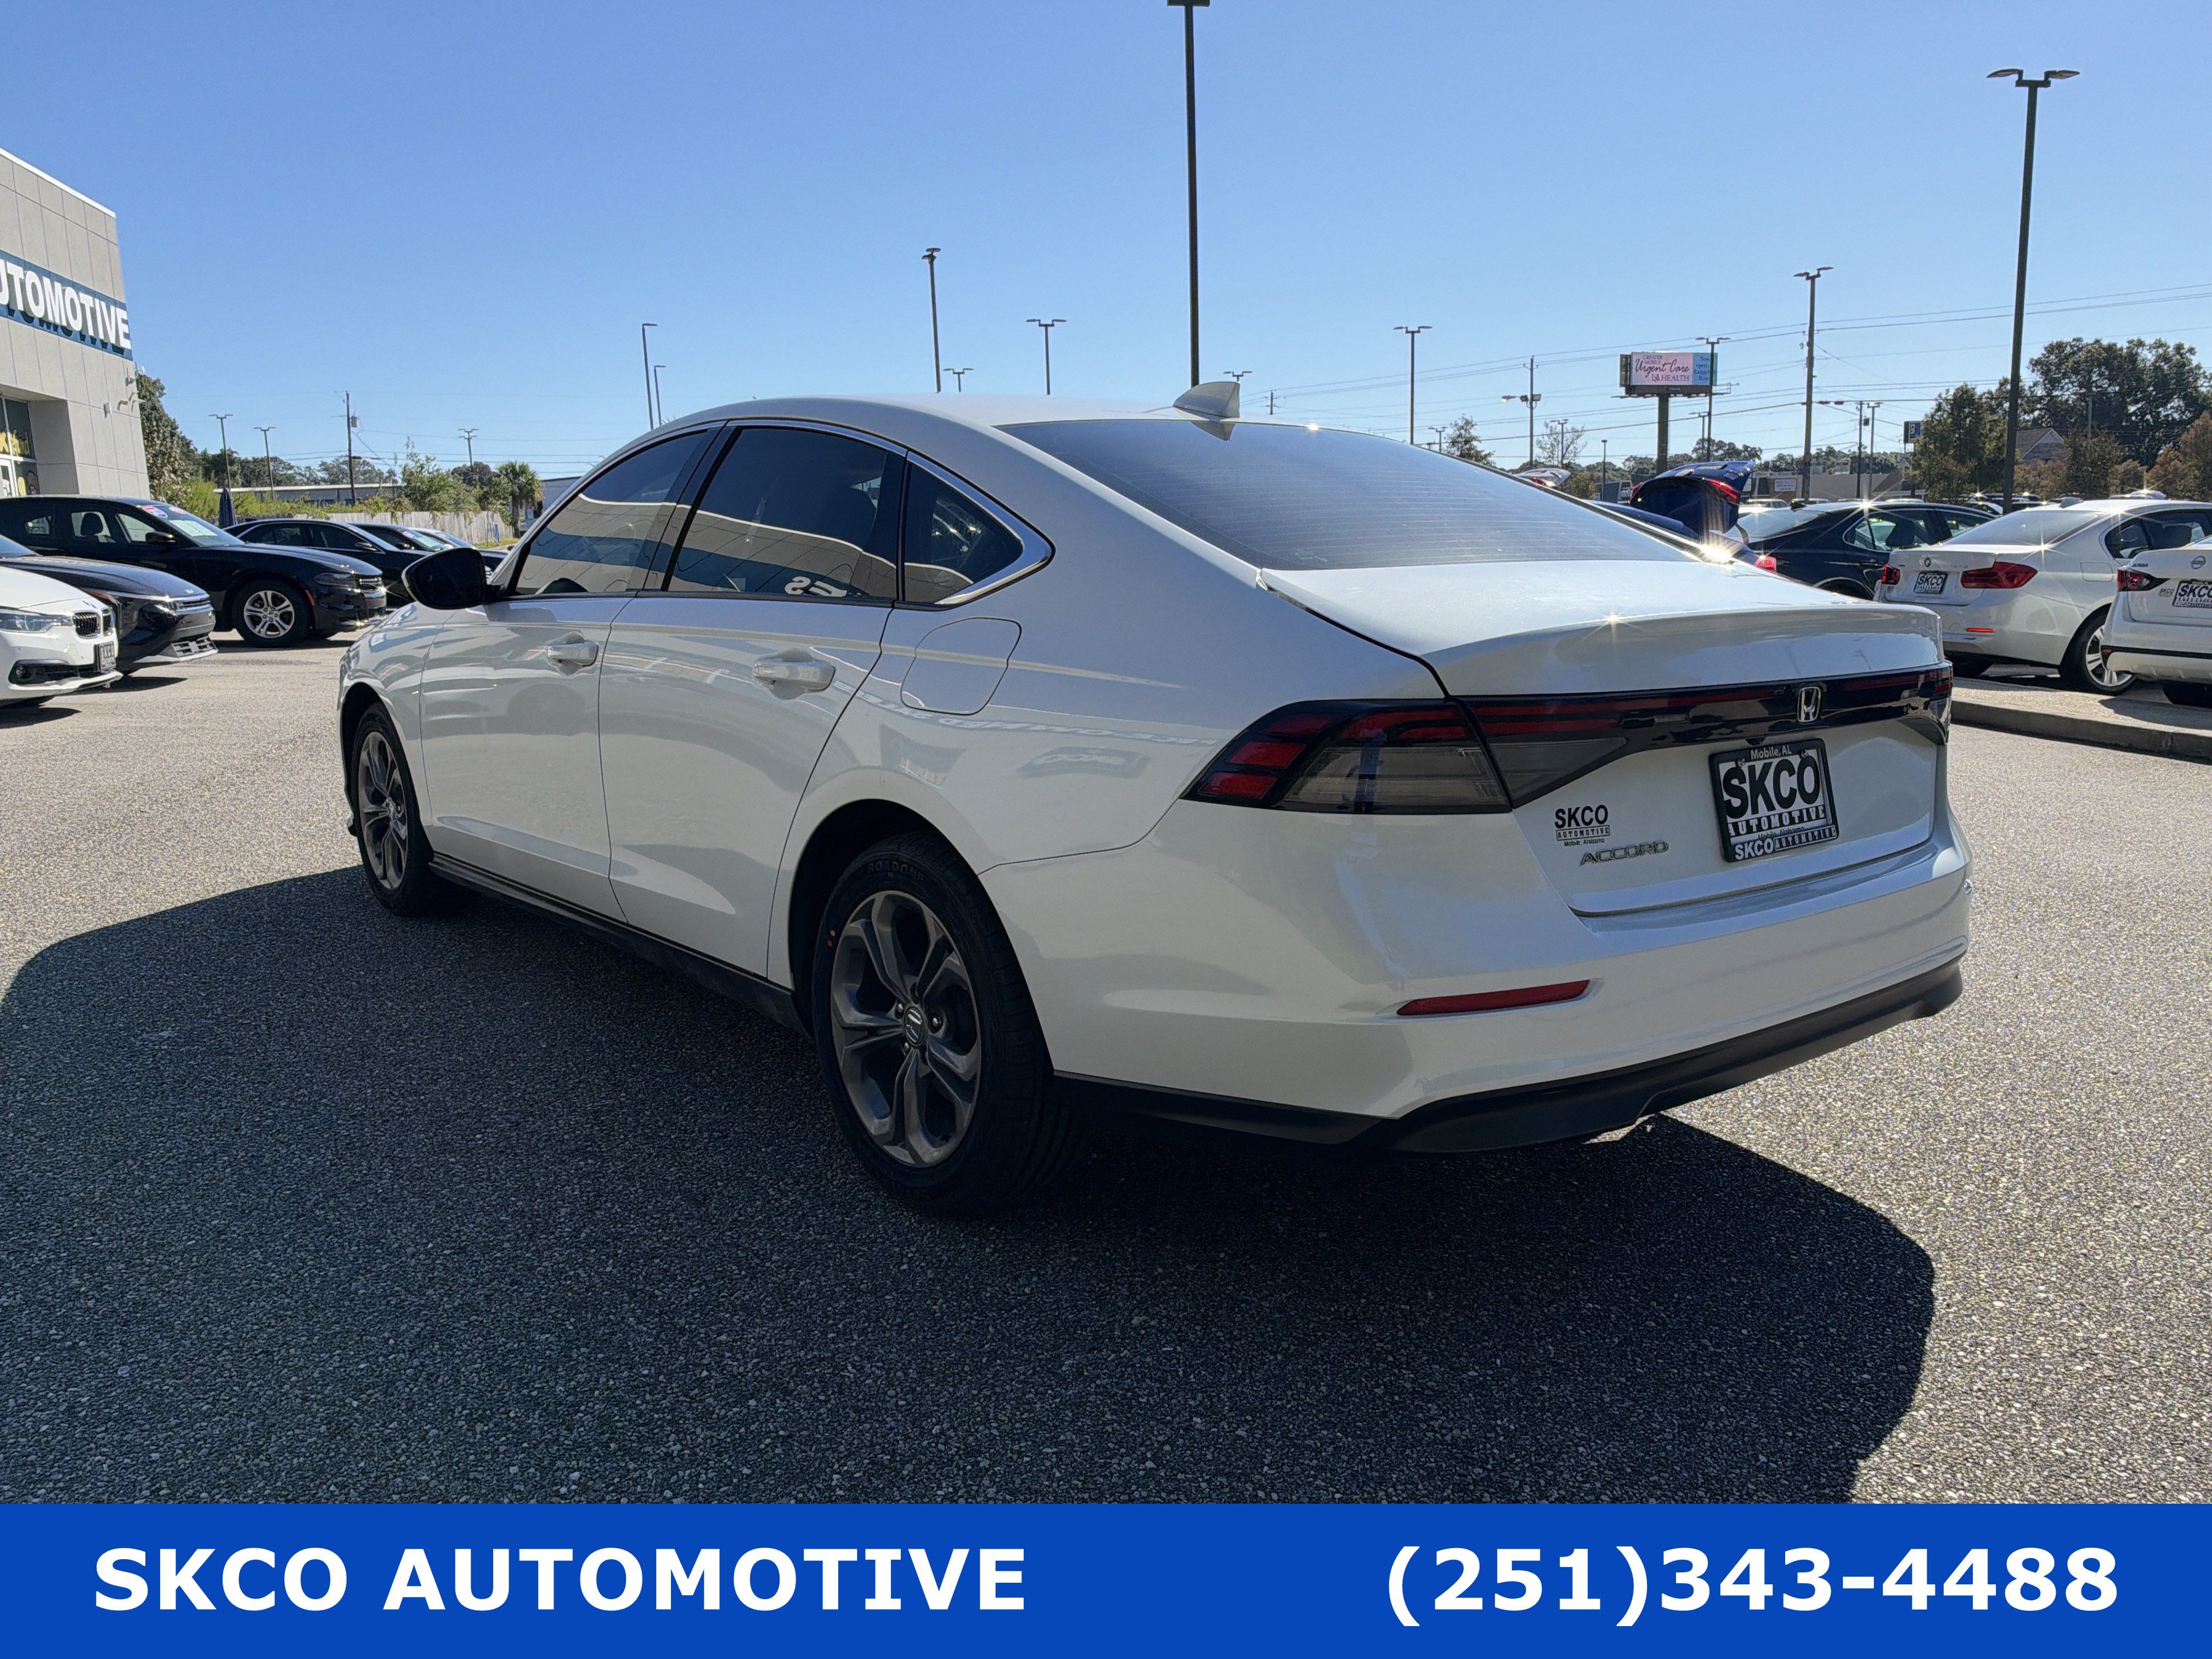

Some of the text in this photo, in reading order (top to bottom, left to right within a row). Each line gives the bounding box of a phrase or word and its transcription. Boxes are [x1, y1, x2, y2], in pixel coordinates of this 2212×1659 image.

[1634, 358, 1690, 378] Urgent Care
[1917, 576, 1943, 586] SKCO
[2178, 584, 2212, 599] SKC
[1750, 744, 1792, 760] Mobile, AL
[1723, 754, 1820, 819] SKCO
[1554, 804, 1609, 829] SKCO
[1728, 805, 1825, 837] AUTOMOTIVE
[1557, 827, 1610, 839] AUTOMOTIVE
[1735, 827, 1836, 860] SKCO AUTOMOTIVE
[1579, 840, 1669, 866] ACCORD
